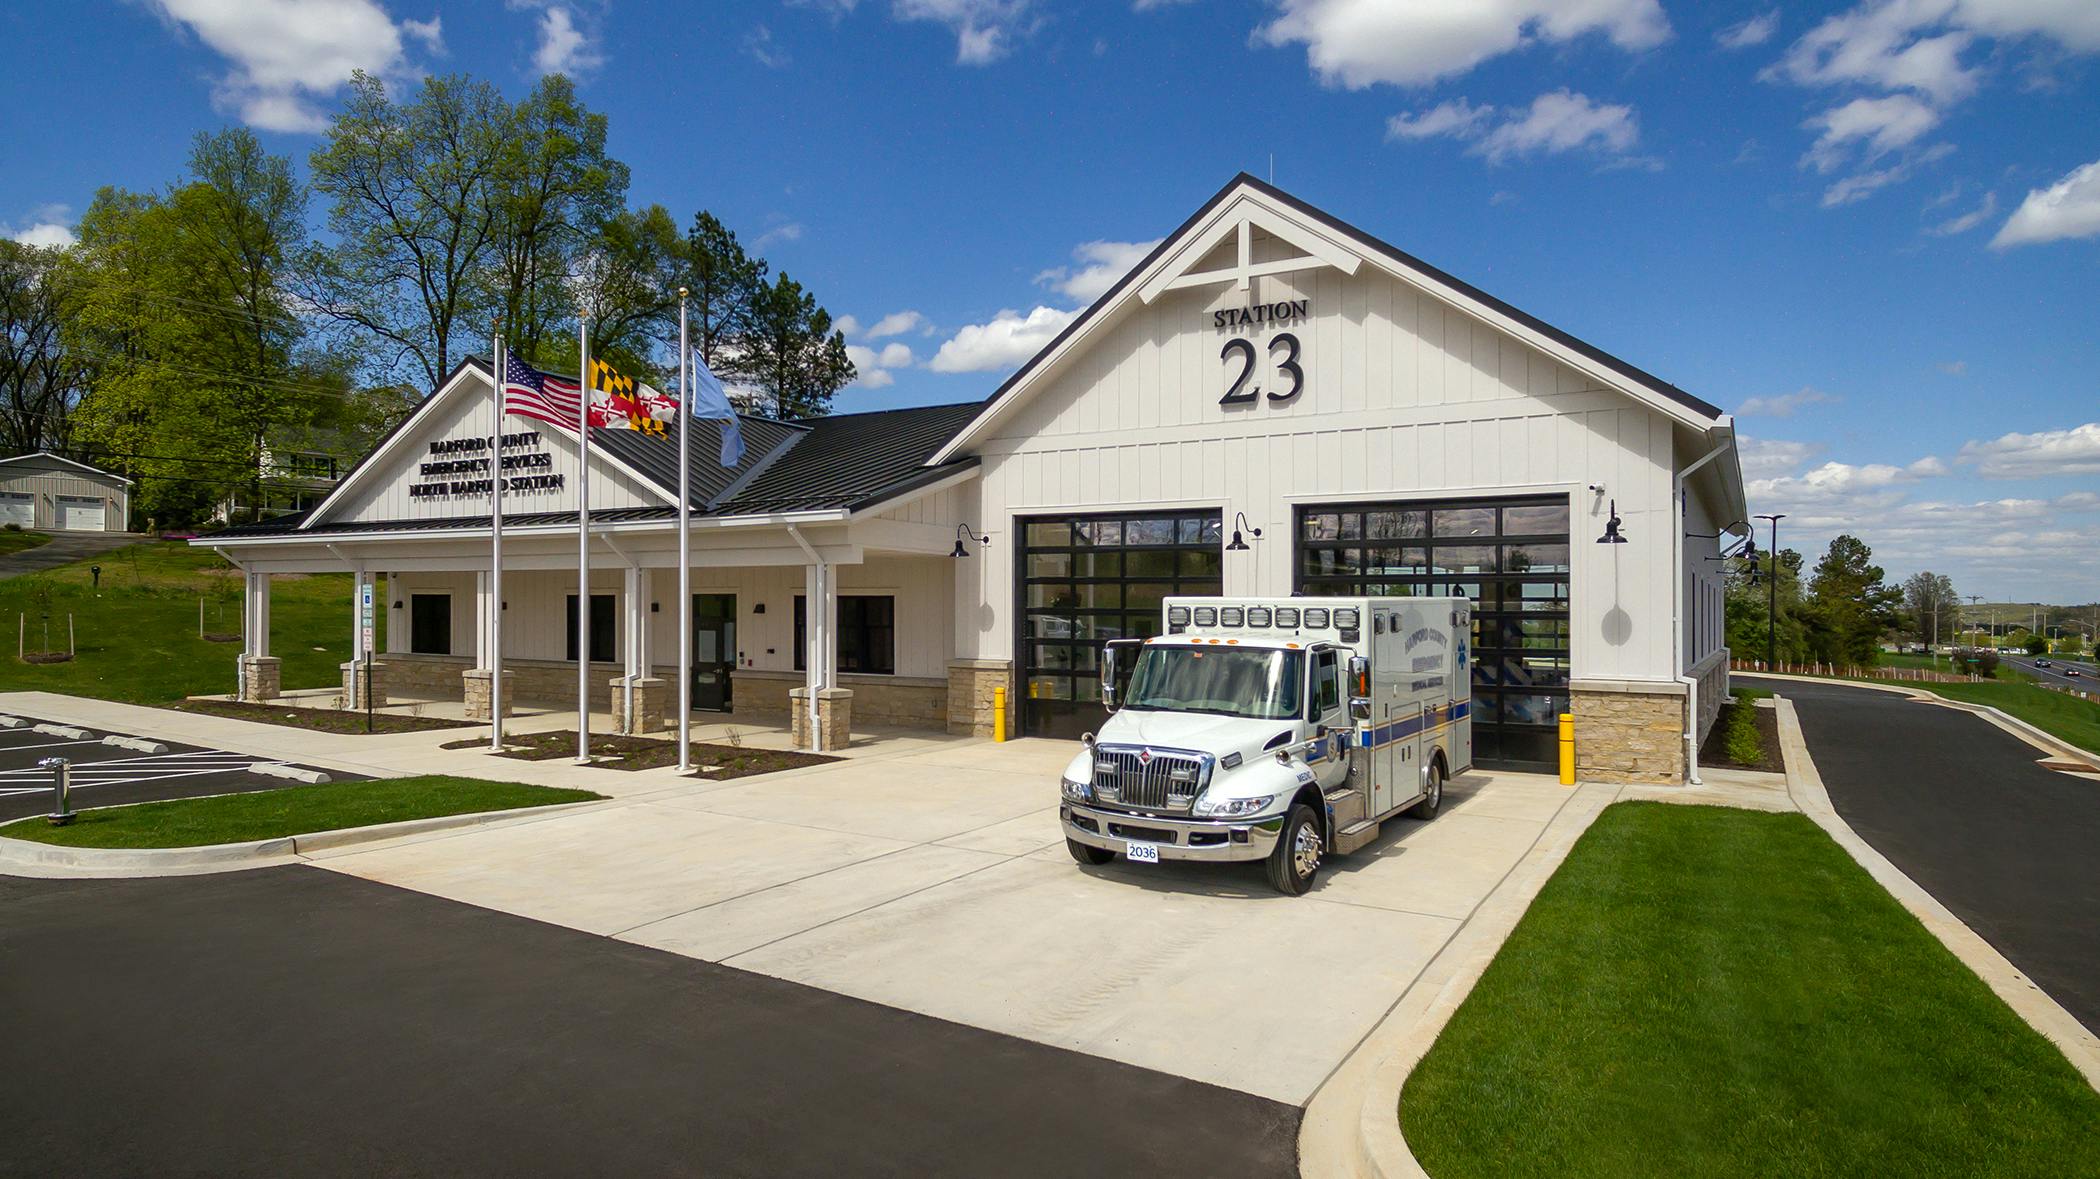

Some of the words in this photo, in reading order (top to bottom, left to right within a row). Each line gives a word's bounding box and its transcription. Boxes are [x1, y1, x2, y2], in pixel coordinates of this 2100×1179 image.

[1214, 300, 1308, 327] STATION
[1219, 333, 1304, 404] 23
[430, 438, 486, 454] HARFORD
[487, 432, 541, 449] CUNTY
[420, 458, 493, 475] EMERGENCY
[495, 453, 552, 470] ERVICES
[409, 483, 448, 496] NORTH
[450, 479, 509, 494] HARFOD
[510, 474, 565, 490] STATION
[1129, 846, 1156, 859] 2036
